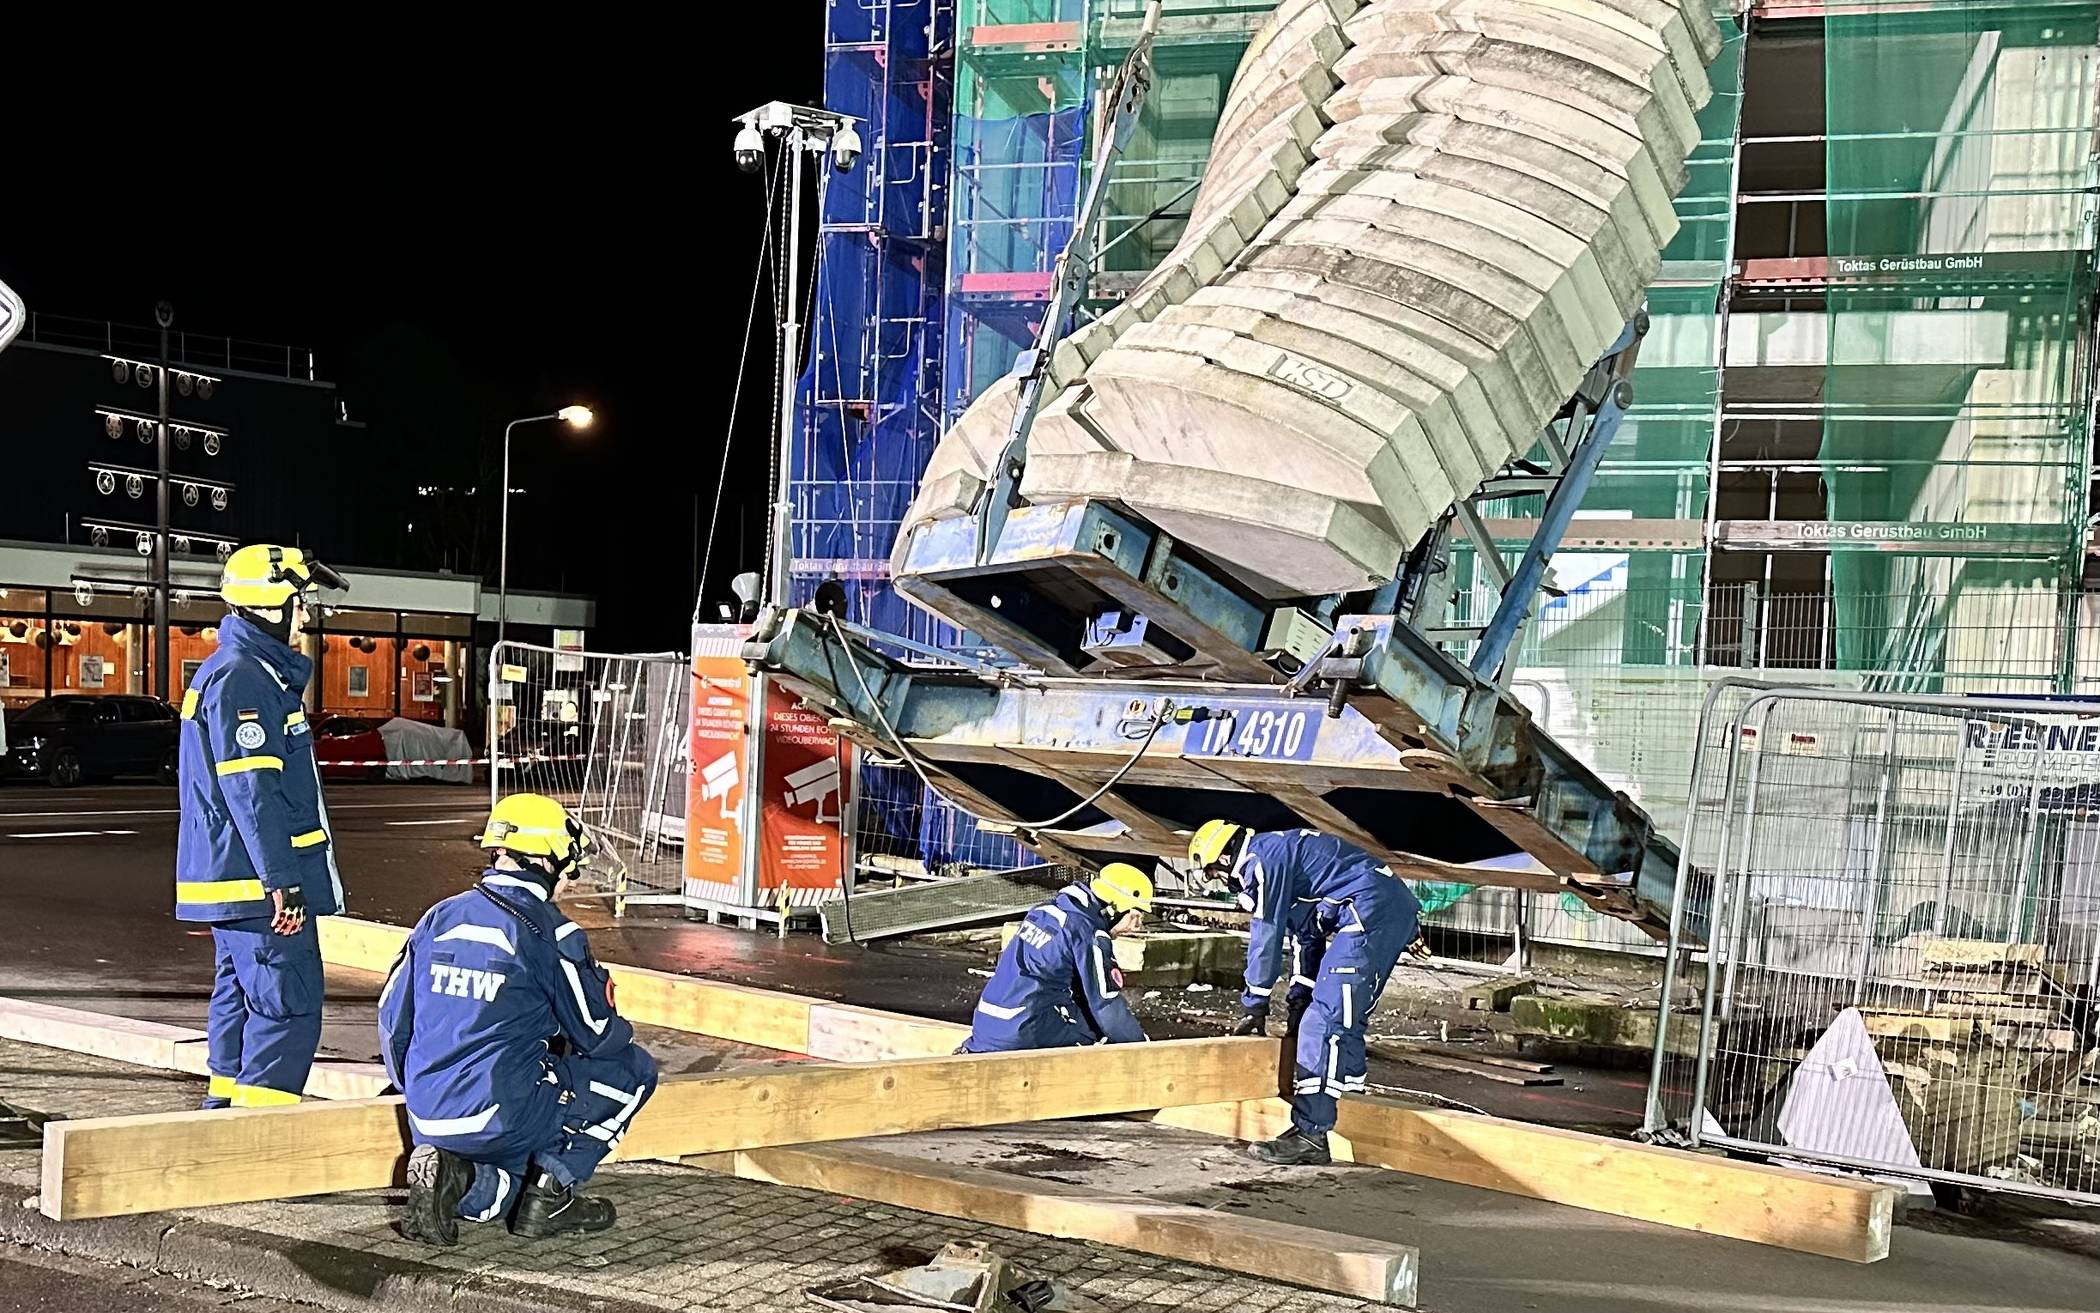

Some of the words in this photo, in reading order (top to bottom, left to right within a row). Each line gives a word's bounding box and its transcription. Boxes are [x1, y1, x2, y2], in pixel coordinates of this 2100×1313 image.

[1837, 260, 1876, 272] Toktas
[1879, 258, 1942, 271] Gerüstbau
[1945, 256, 1983, 269] GmbH
[1795, 523, 1846, 538] Toktas
[1938, 524, 1987, 539] GmbH
[773, 712, 798, 722] DIESES
[780, 723, 815, 733] STUNDEN
[1238, 710, 1306, 757] 4310
[430, 963, 506, 1003] THW
